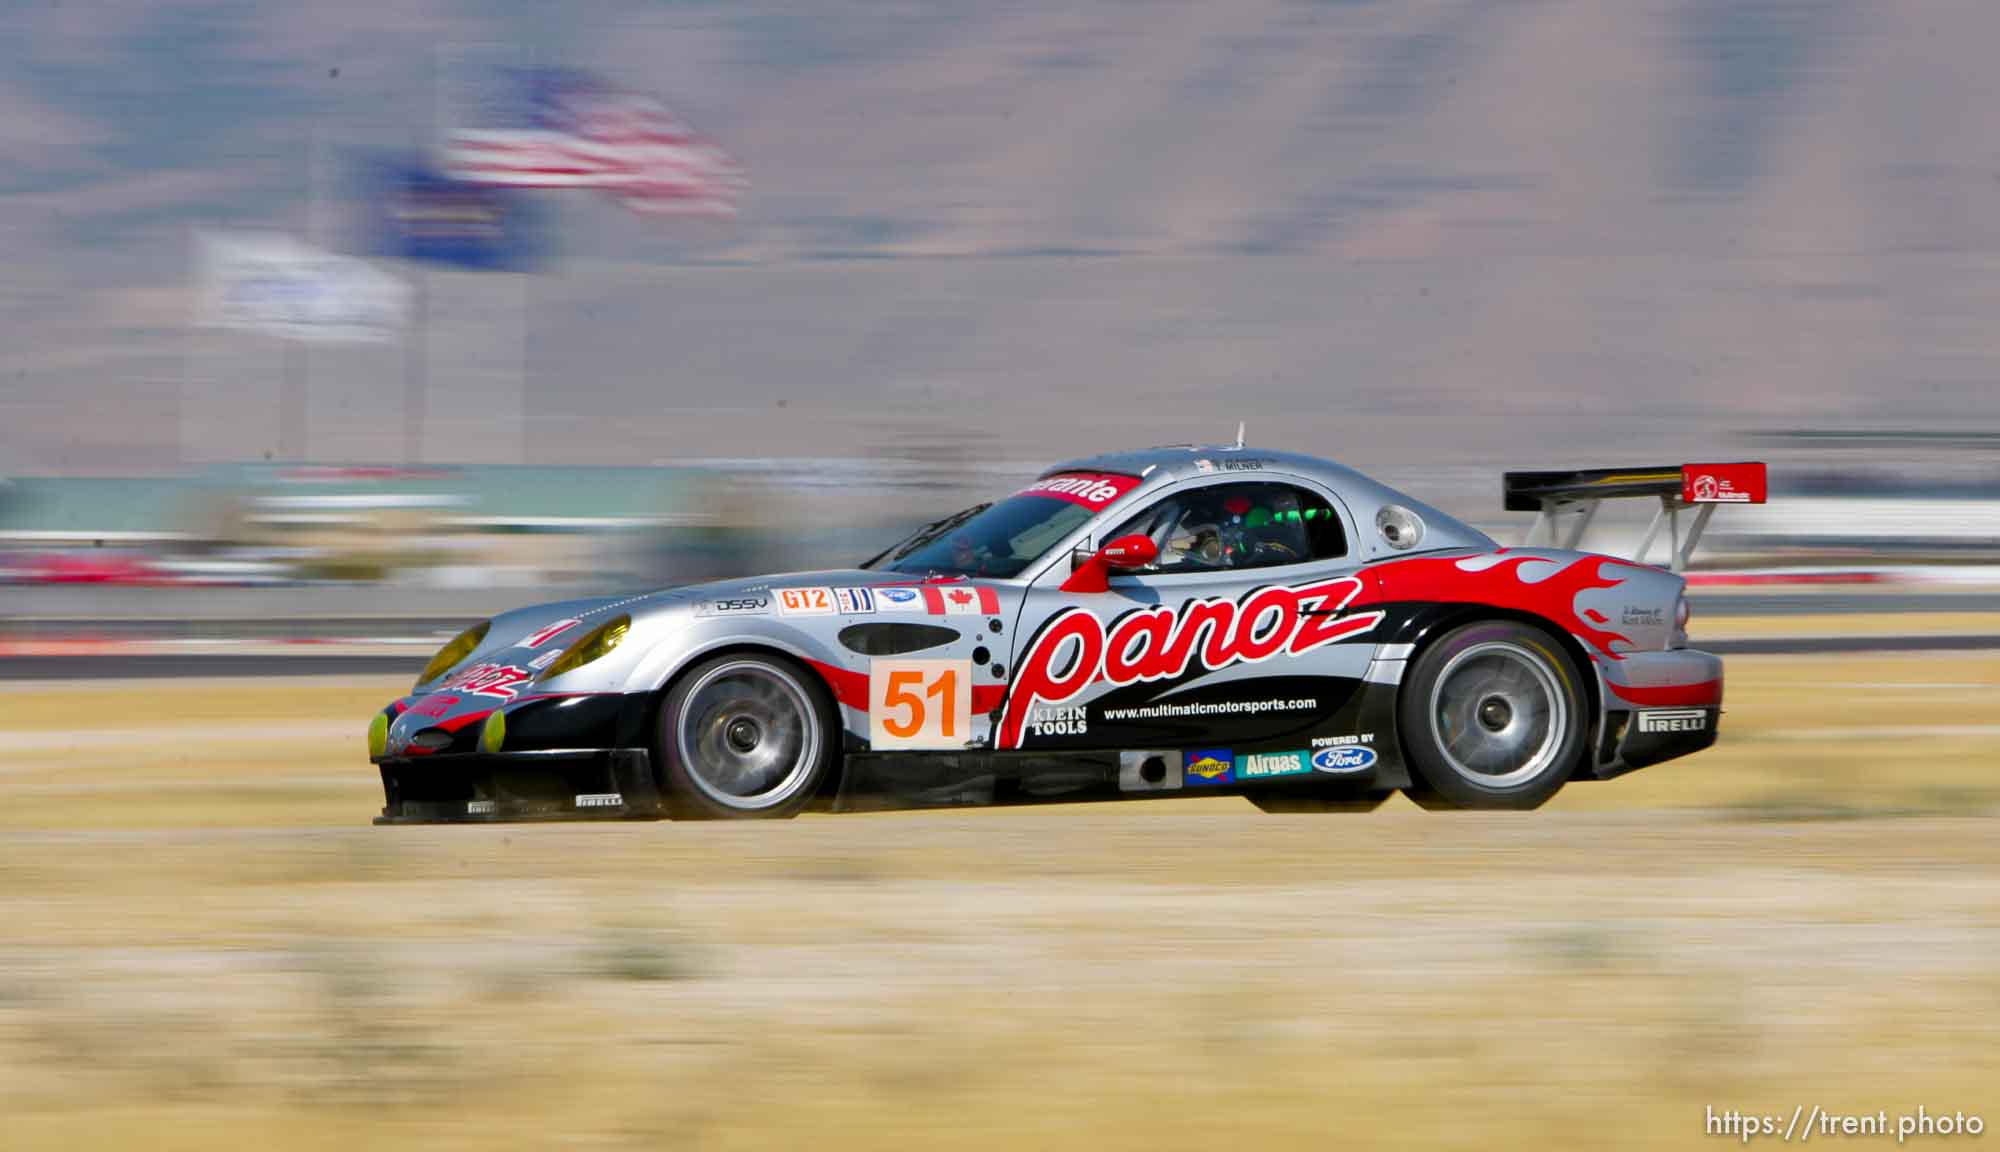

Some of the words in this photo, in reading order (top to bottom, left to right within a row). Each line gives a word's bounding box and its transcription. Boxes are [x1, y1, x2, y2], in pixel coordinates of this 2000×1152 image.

[783, 588, 829, 609] GT2
[882, 670, 955, 738] 51
[1033, 706, 1087, 721] KLEIN
[1104, 697, 1317, 720] www.multimaticmotorsports.com
[1032, 719, 1088, 735] TOOLS
[1638, 709, 1707, 732] PIRELLI
[1311, 735, 1358, 747] POWERED
[1361, 733, 1375, 745] BY
[1247, 752, 1302, 776] Airgas
[1325, 749, 1365, 767] Ford
